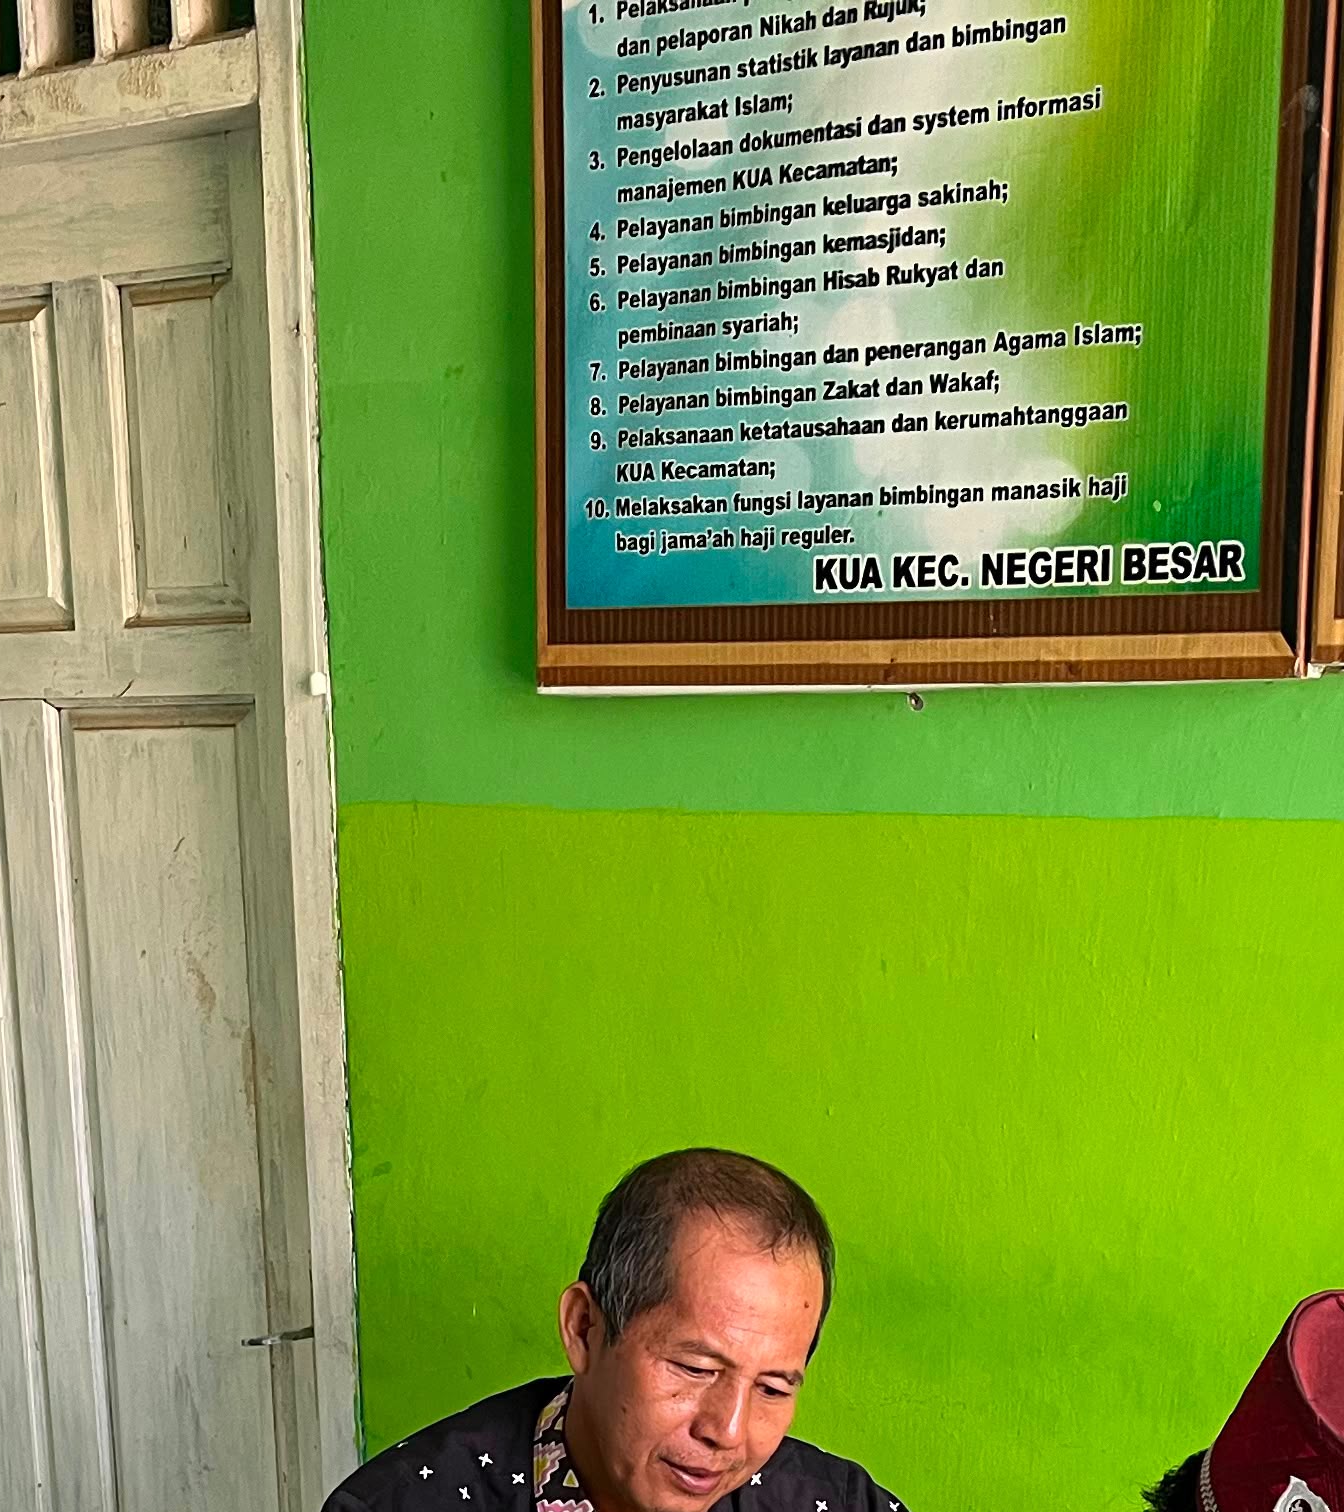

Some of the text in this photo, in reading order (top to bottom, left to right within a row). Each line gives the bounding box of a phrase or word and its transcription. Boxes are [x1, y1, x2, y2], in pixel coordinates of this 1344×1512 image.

[588, 3, 605, 24] 1.
[617, 37, 650, 58] dan
[656, 23, 753, 57] pelaporan
[760, 10, 817, 38] Nikah
[822, 5, 858, 28] dan
[588, 17, 1066, 98] 2. Penyusunan statistik layanan dan bimbingan
[589, 87, 1101, 171] 3. Pengelolaan dokumentasi dan system informasi
[617, 93, 793, 132] masyarakat Islam;
[617, 155, 898, 203] manajemen KUA Kecamatan;
[589, 179, 1008, 242] 4. Pelayanan bimbingan keluarga sakinah;
[589, 225, 946, 277] 5. Pelayanan bimbingan kemasjidan;
[589, 258, 1004, 312] 6. Pelayanan bimbingan Hisab Rukyat dan
[589, 323, 1142, 382] 7. Pelayanan bimbingan dan penerangan Agama Islam;
[618, 311, 799, 350] pembinaan syariah;
[590, 369, 1000, 417] 8. Pelayanan bimbingan Zakat dan Wakaf;
[590, 403, 1128, 450] 9. Pelaksanaan ketatausahaan dan kerumahtanggaan
[616, 458, 776, 483] KUA Kecamatan;
[585, 474, 1127, 519] 10. Melaksakan fungsi layanan bimbingan manasik haji
[616, 531, 655, 555] bagi
[740, 526, 775, 551] haji
[781, 525, 855, 550] reguler.
[815, 543, 1244, 590] KUA KEC. NEGERI BESAR
